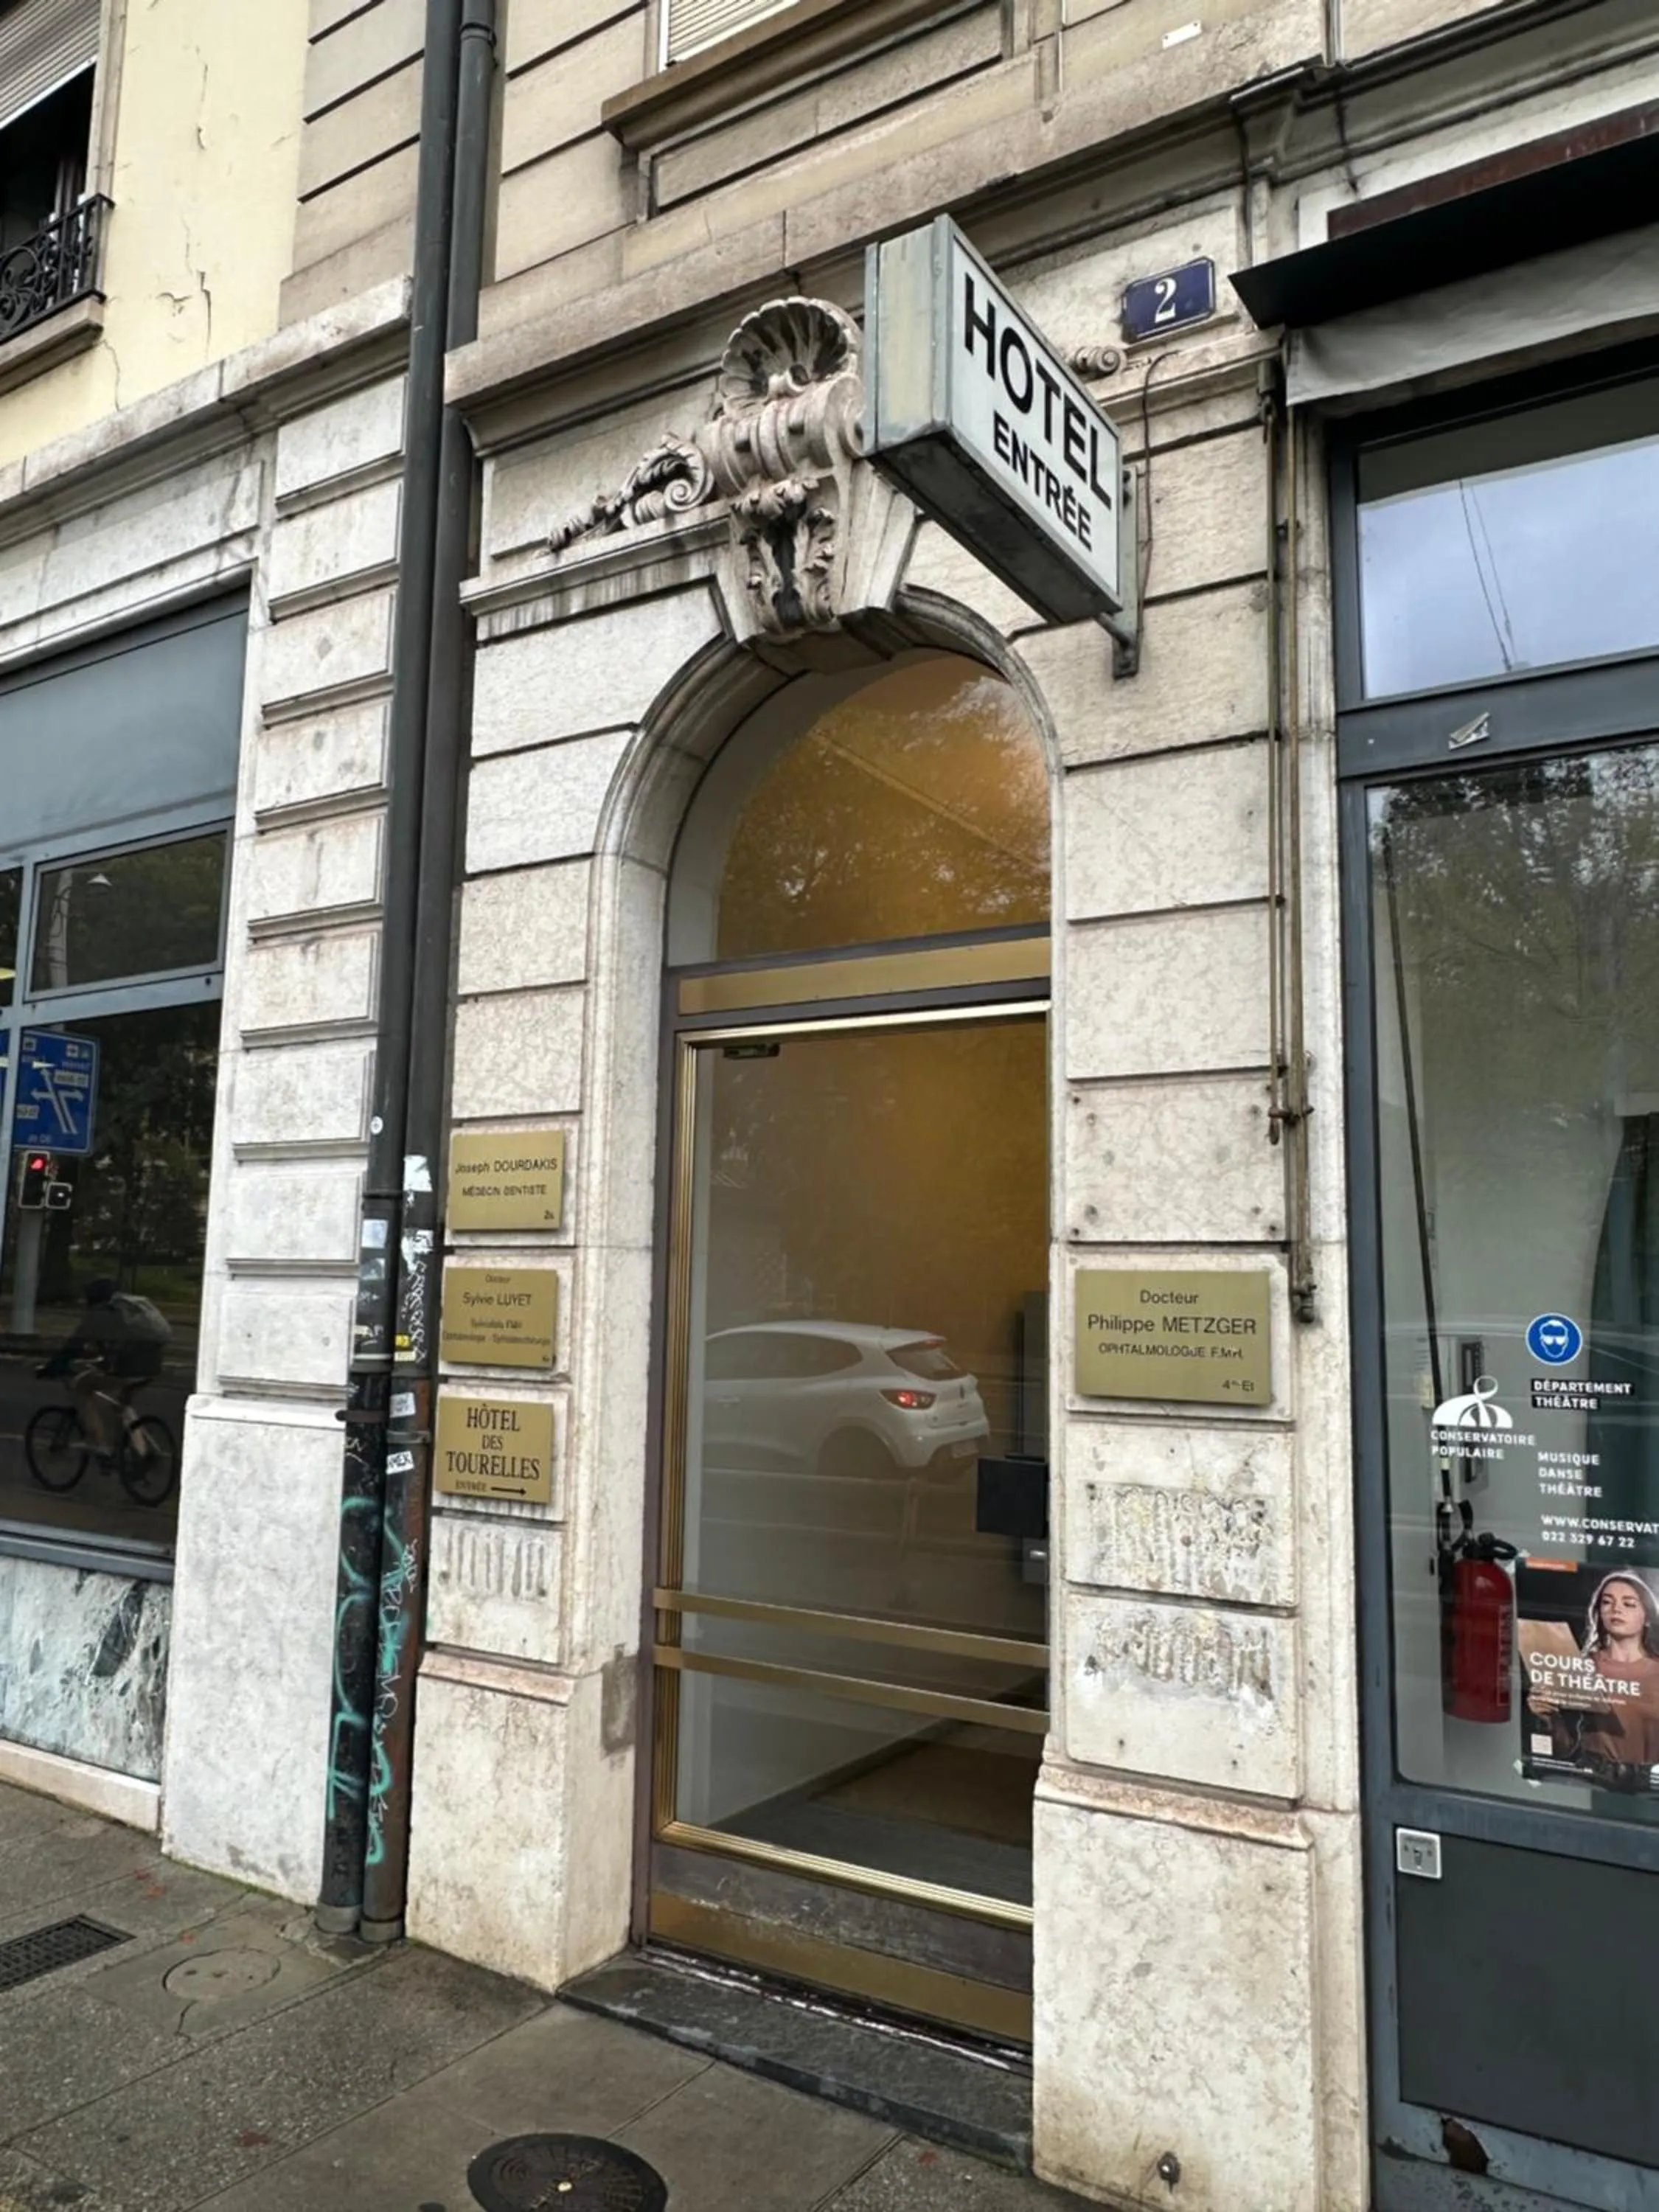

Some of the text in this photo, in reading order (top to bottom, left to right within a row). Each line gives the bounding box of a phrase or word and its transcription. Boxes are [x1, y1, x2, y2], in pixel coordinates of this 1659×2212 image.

[1154, 276, 1177, 324] 2
[964, 272, 1112, 511] HOTEL
[993, 410, 1092, 552] ENTRÉE
[454, 1157, 558, 1175] Joseph DOURDAKIS
[1140, 1289, 1199, 1305] Docteur
[1087, 1314, 1257, 1335] Philippe METZGER
[1098, 1342, 1206, 1358] OPHTALMOLOGUE
[1533, 1379, 1632, 1394] DÉPARTEMENT
[1534, 1395, 1599, 1410] THÉÂTRE
[466, 1403, 521, 1432] HÔTEL
[481, 1434, 504, 1450] DES
[1430, 1430, 1536, 1446] CONSERVATOIRE
[1430, 1445, 1505, 1459] POPULAIRE
[1537, 1451, 1600, 1467] MUSIQUE
[446, 1450, 540, 1481] TOURELLES
[1538, 1467, 1584, 1481] DANSE
[1539, 1481, 1604, 1498] THÉÂTRE
[1541, 1530, 1566, 1543] 022
[1569, 1533, 1595, 1545] 329
[1618, 1537, 1635, 1548] 22
[1530, 1652, 1596, 1674] COURS
[1531, 1669, 1641, 1697] DE THÉÂTRE
